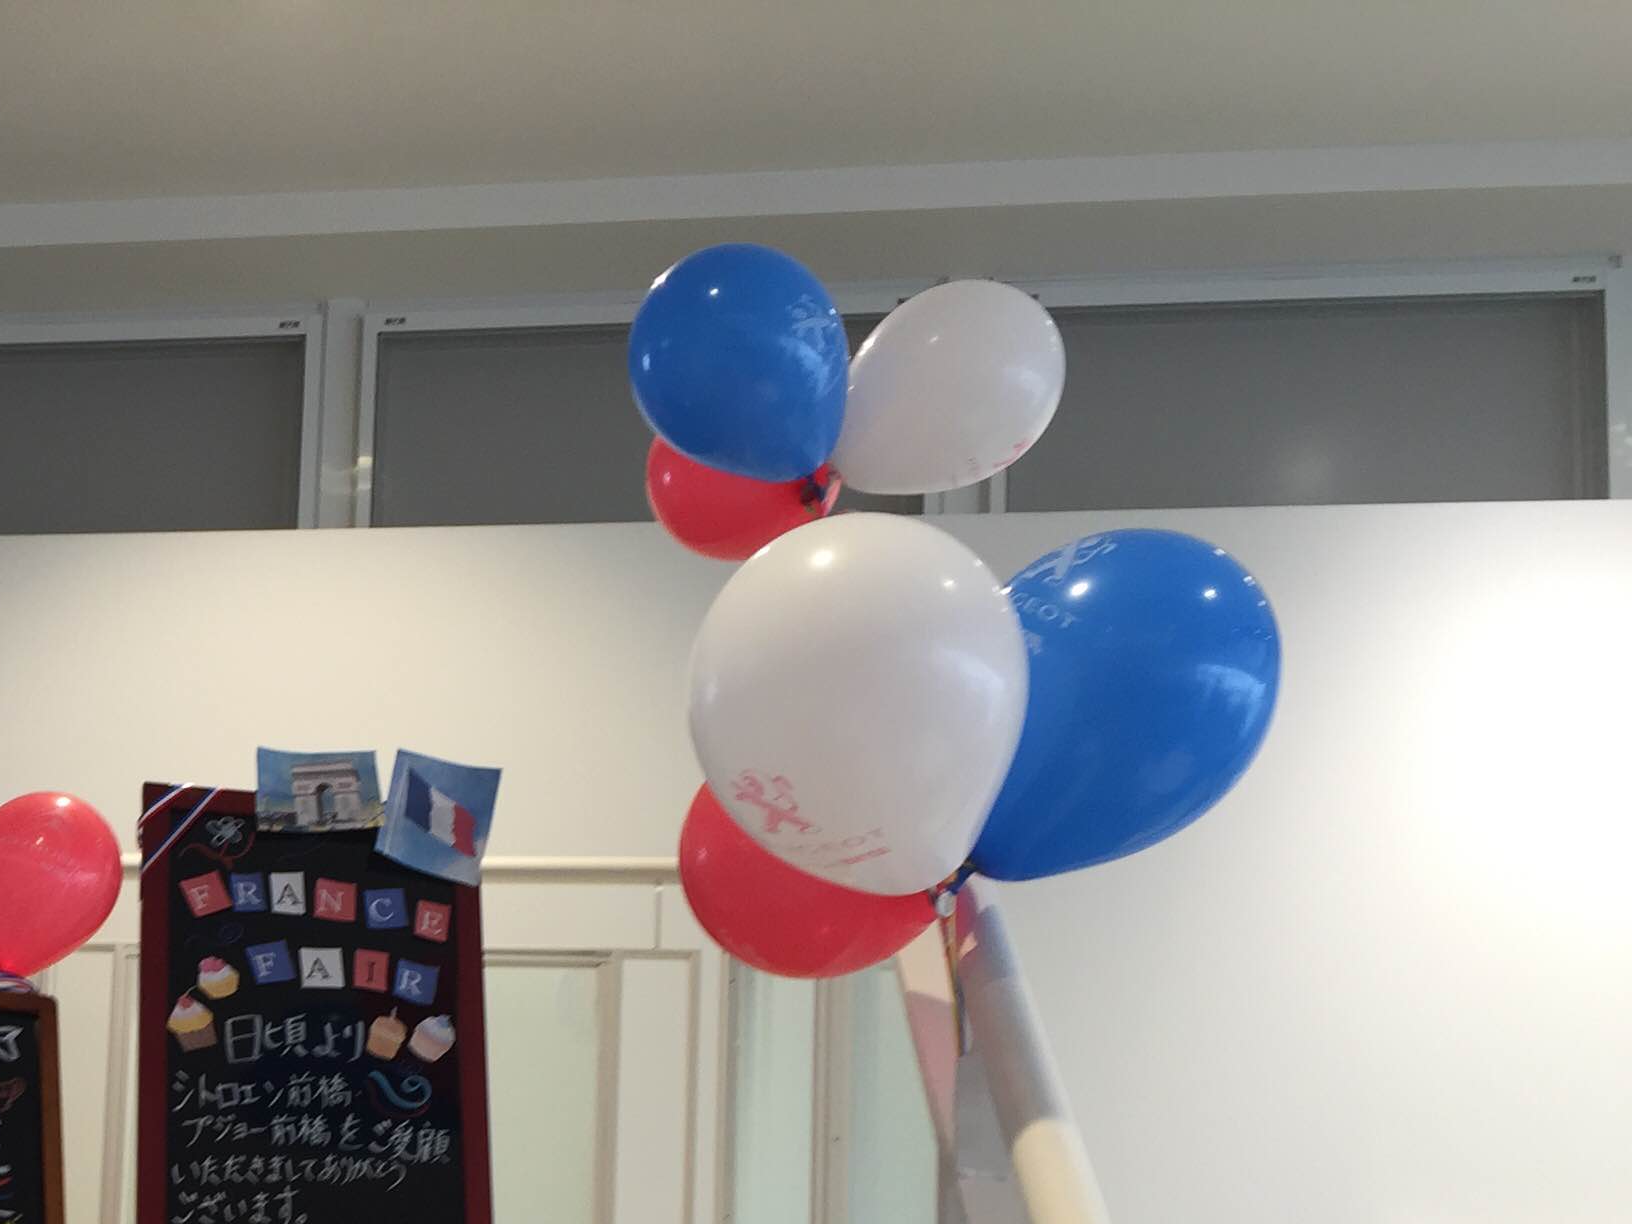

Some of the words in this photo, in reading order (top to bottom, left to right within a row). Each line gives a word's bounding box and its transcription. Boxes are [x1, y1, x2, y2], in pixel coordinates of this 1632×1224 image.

[188, 878, 445, 937] FRANCE
[250, 951, 424, 997] FAIR
[223, 1012, 366, 1064] 日頃より
